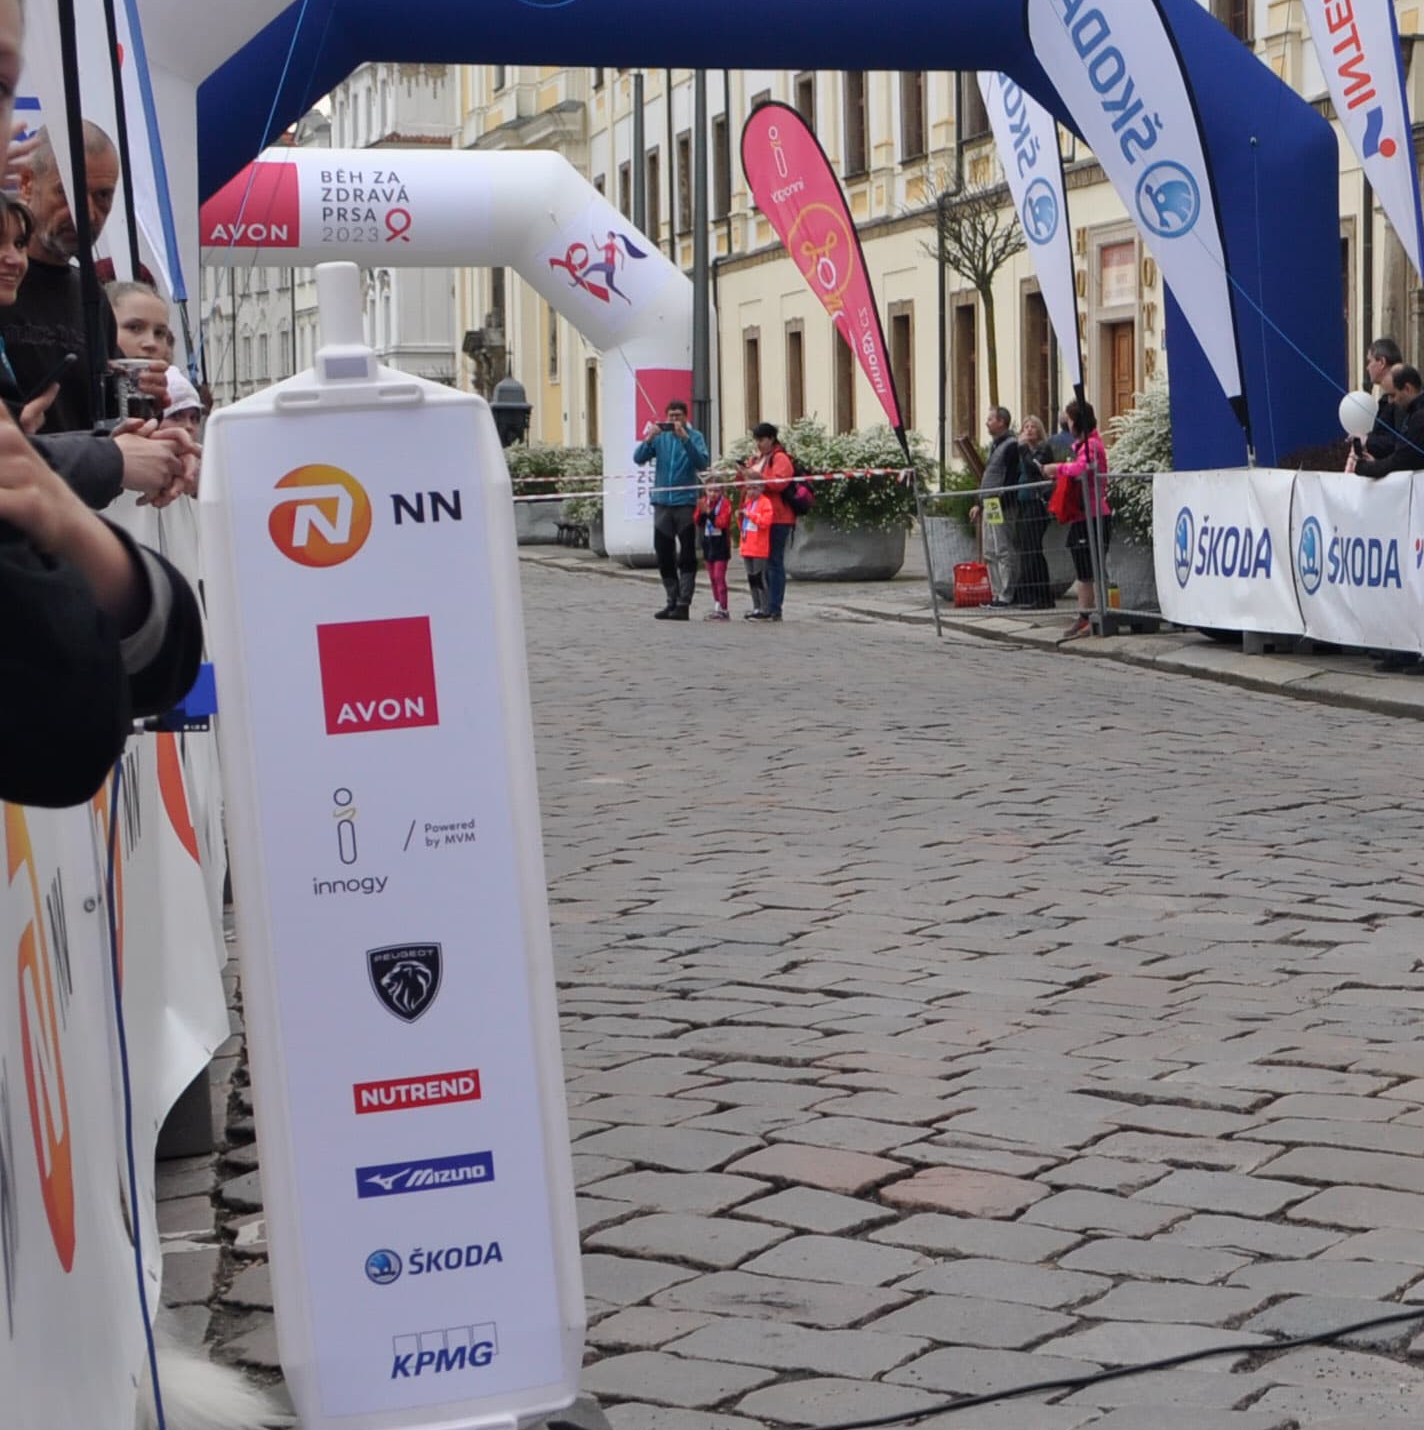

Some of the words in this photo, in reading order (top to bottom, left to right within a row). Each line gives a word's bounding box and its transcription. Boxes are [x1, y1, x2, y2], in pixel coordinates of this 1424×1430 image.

[374, 171, 400, 183] ZA
[321, 185, 410, 203] ZDRAVÁ
[322, 207, 377, 221] PRSA
[211, 224, 289, 241] AVON
[322, 226, 378, 242] 2023
[391, 490, 462, 524] NN
[1195, 516, 1272, 579] ŠKODA
[337, 697, 425, 724] AVON
[424, 819, 475, 833] Powered
[425, 837, 440, 849] by
[445, 832, 475, 844] MVM
[313, 874, 389, 896] innogy
[374, 949, 434, 962] PEUGEOT
[361, 1076, 475, 1107] NUTREND
[408, 1241, 503, 1275] ŠKODA
[391, 1340, 495, 1379] KPMG
